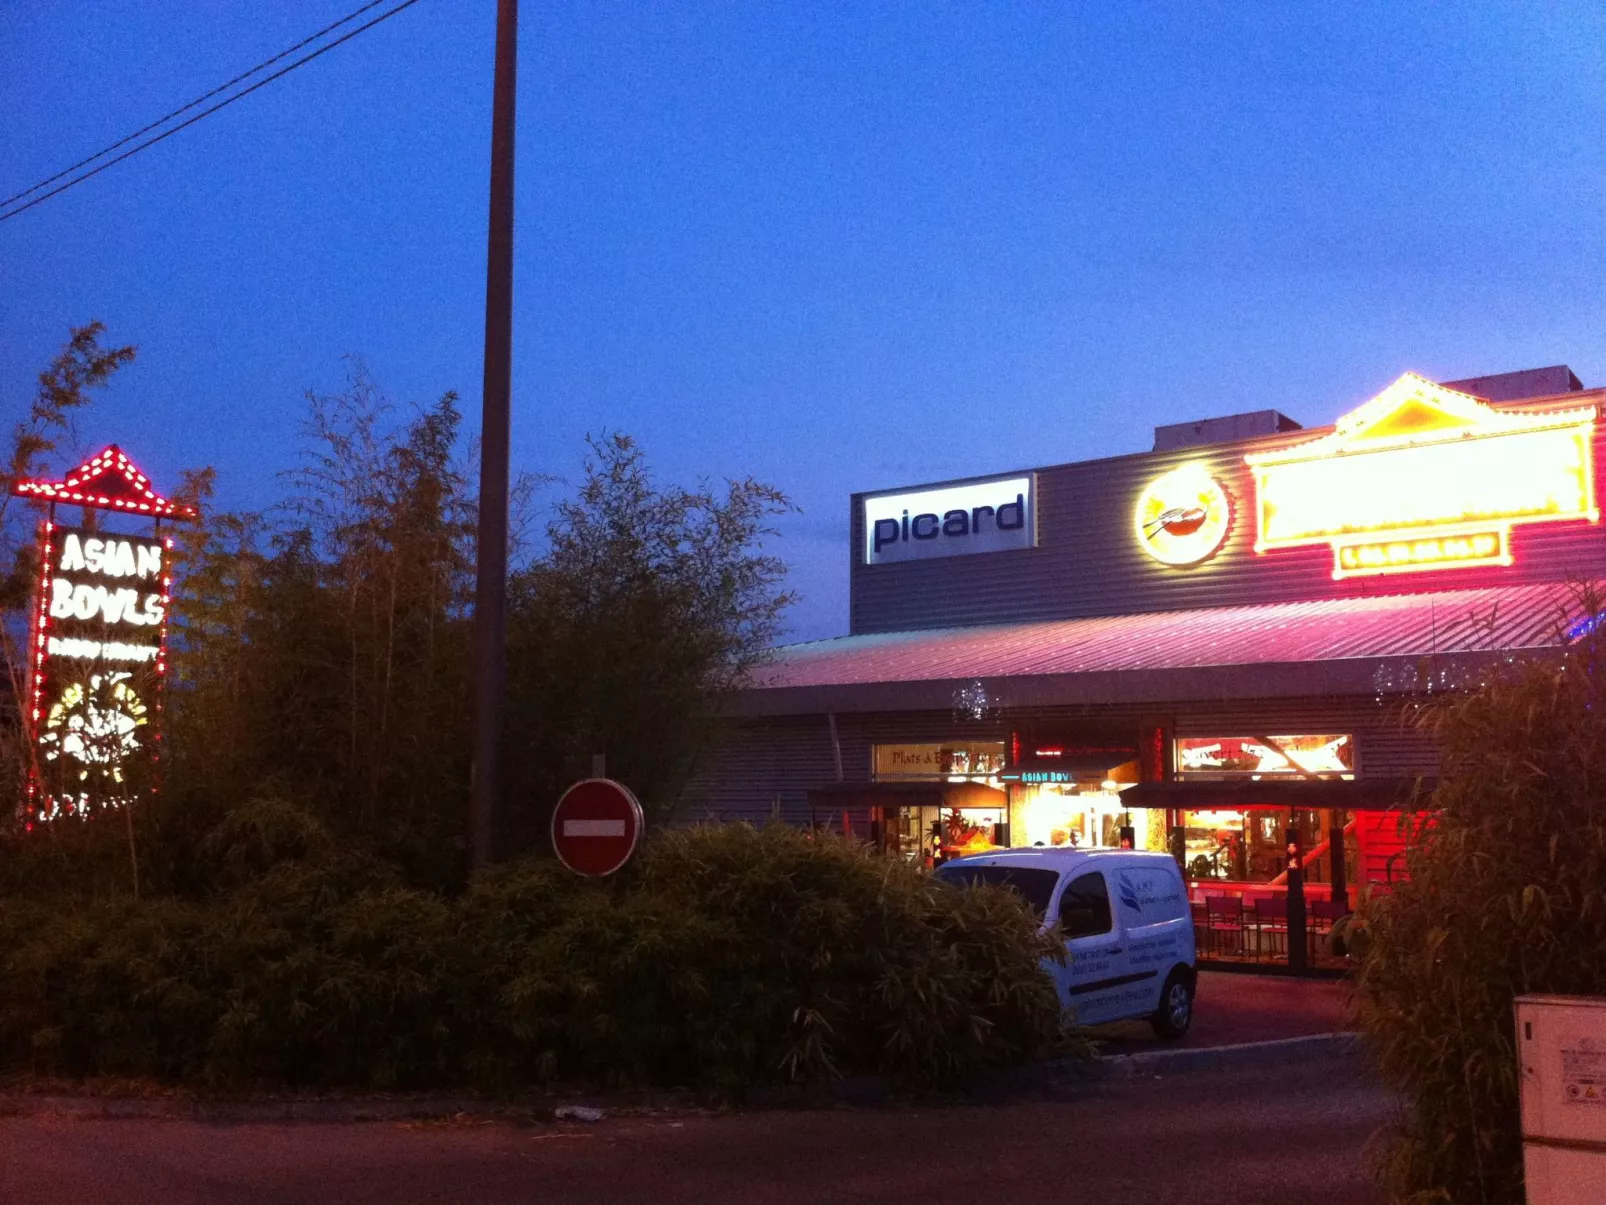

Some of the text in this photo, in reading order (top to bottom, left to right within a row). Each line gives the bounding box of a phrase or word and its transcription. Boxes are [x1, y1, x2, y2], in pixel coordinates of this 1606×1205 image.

[874, 493, 1024, 553] picard
[60, 533, 162, 580] ASIAN
[49, 579, 165, 626] BOWLS
[893, 750, 921, 765] Plats
[1022, 772, 1048, 782] ASIAN
